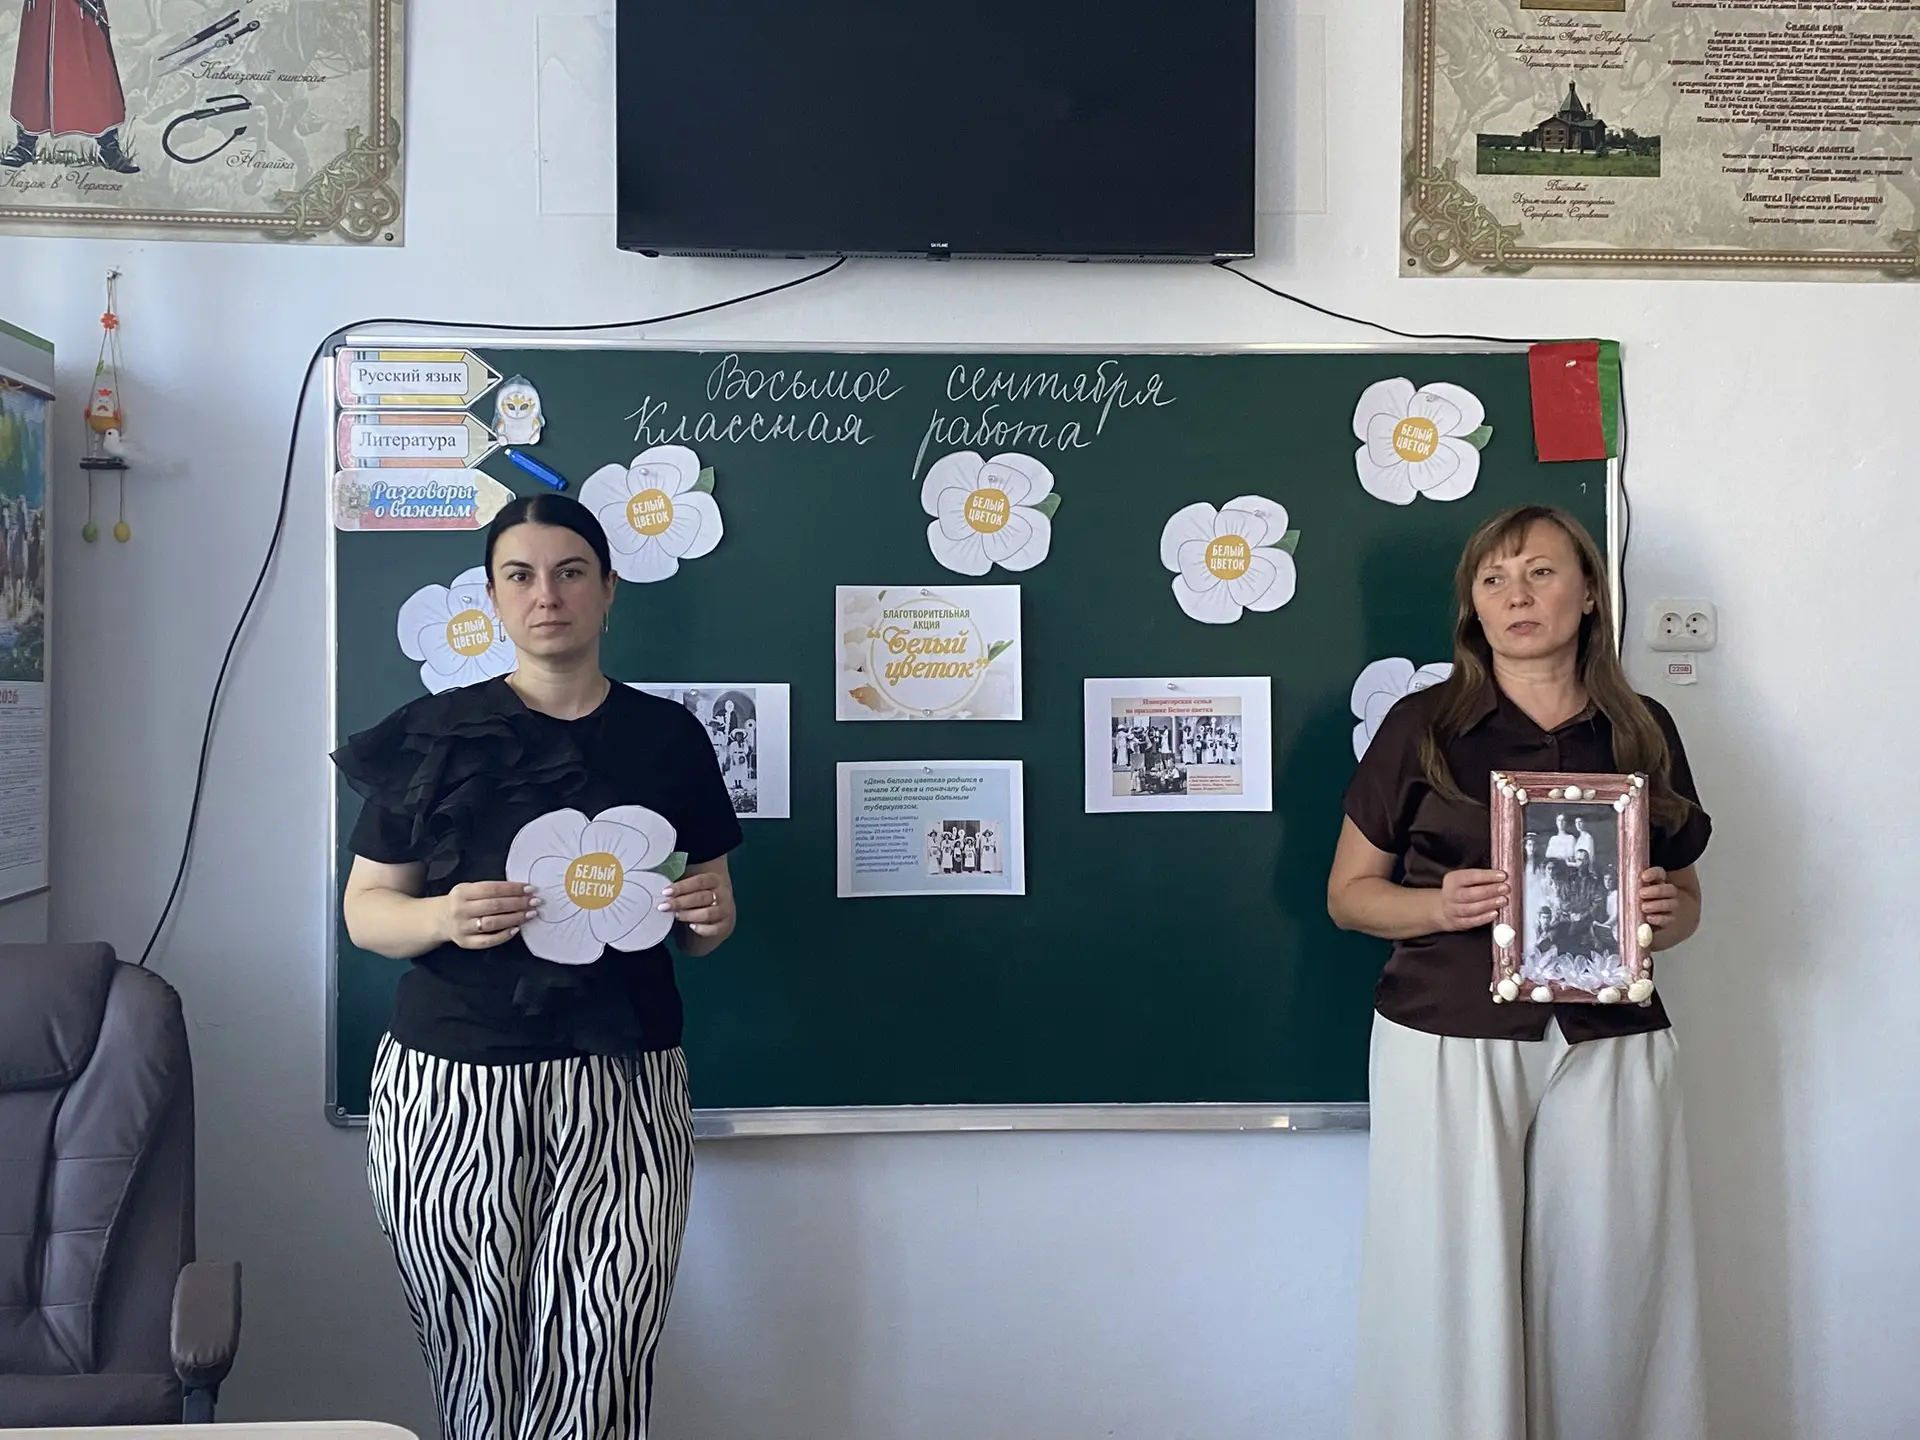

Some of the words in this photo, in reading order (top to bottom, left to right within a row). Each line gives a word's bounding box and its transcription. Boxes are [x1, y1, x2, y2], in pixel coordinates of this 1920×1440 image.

[192, 60, 275, 83] Кавказский
[277, 71, 327, 84] кинжал
[226, 149, 295, 170] Нагайка
[0, 169, 46, 191] Казак
[51, 175, 60, 190] в
[358, 368, 421, 385] Русский
[425, 371, 462, 383] язык
[707, 354, 905, 402] Восьмое
[947, 360, 1177, 434] сентября
[624, 395, 874, 446] Классная
[912, 402, 1091, 480] работа
[1401, 423, 1433, 442] БЕЛЫЙ
[359, 432, 456, 452] Литература
[1396, 436, 1431, 456] ЦВЕТОК
[372, 481, 475, 502] Разговоры
[375, 506, 385, 518] о
[390, 501, 472, 518] важном
[632, 495, 665, 514] БЕЛЫЙ
[972, 496, 1004, 512] БЕЛЫЙ
[634, 511, 669, 529] ЦВЕТОК
[969, 508, 1003, 526] ЦВЕТОК
[1212, 543, 1244, 557] БЕЛЫЙ
[1210, 558, 1245, 570] ЦВЕТОК
[883, 609, 970, 619] БЛАГОТВОРИТЕЛЬНАЯ
[452, 616, 485, 635] БЕЛЫЙ
[913, 620, 940, 630] АКЦИЯ
[453, 631, 490, 650] ЦВЕТОК
[947, 776, 976, 784] родился
[925, 786, 959, 794] поначалу
[575, 864, 616, 881] БЕЛЫЙ
[571, 880, 615, 898] ЦВЕТОК
